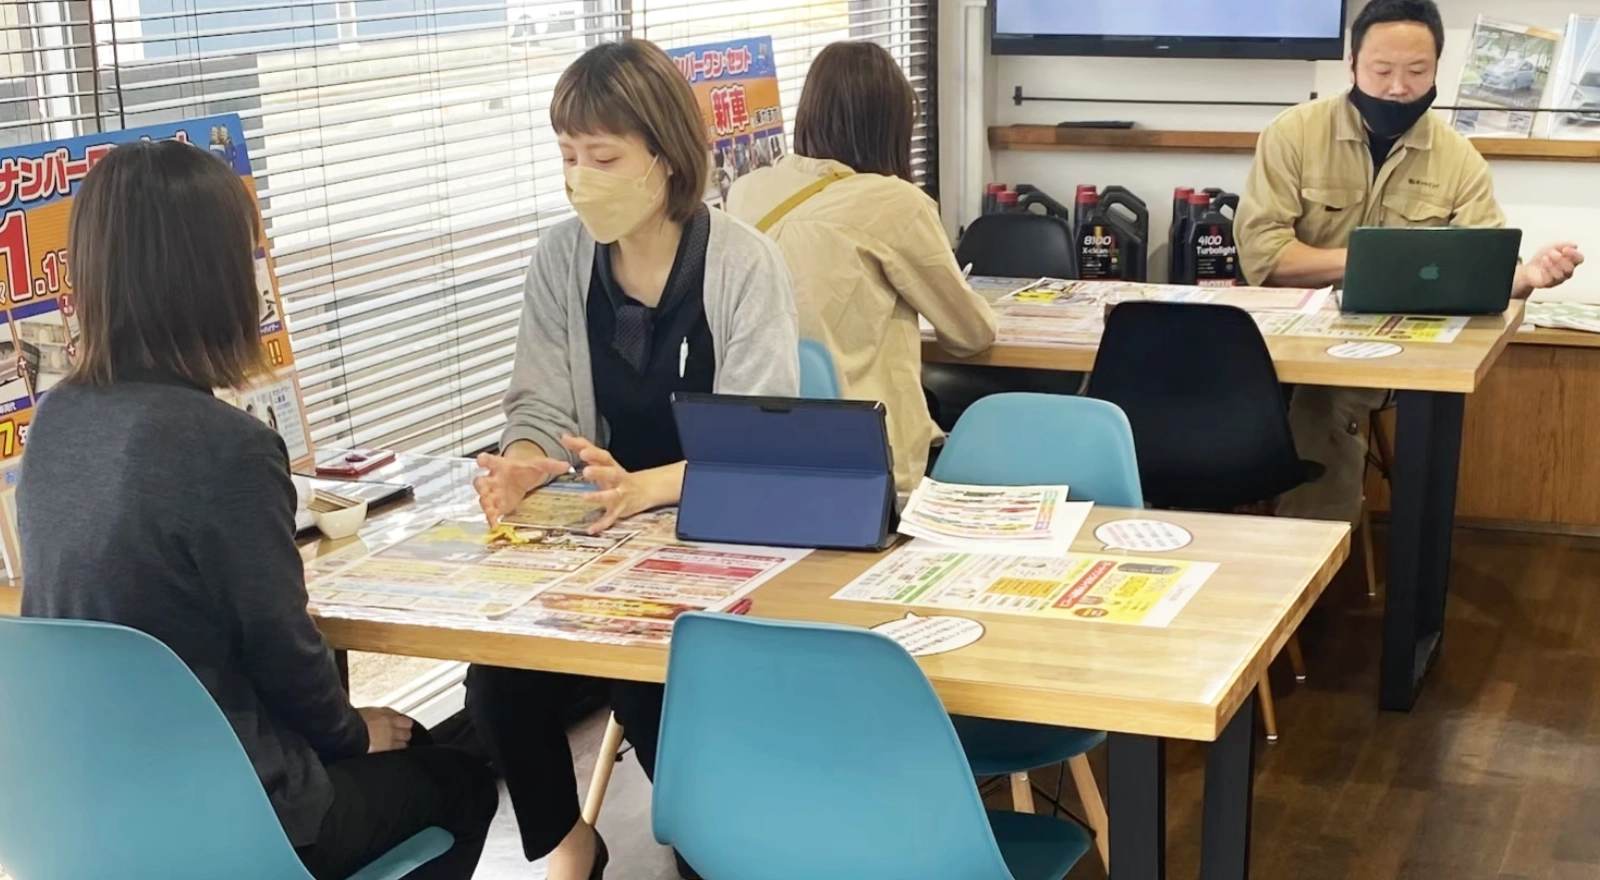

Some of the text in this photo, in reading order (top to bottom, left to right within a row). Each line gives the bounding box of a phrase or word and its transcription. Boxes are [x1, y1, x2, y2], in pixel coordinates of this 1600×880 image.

[711, 85, 749, 135] 新車
[1083, 235, 1112, 246] 8100
[1197, 235, 1222, 246] 4100
